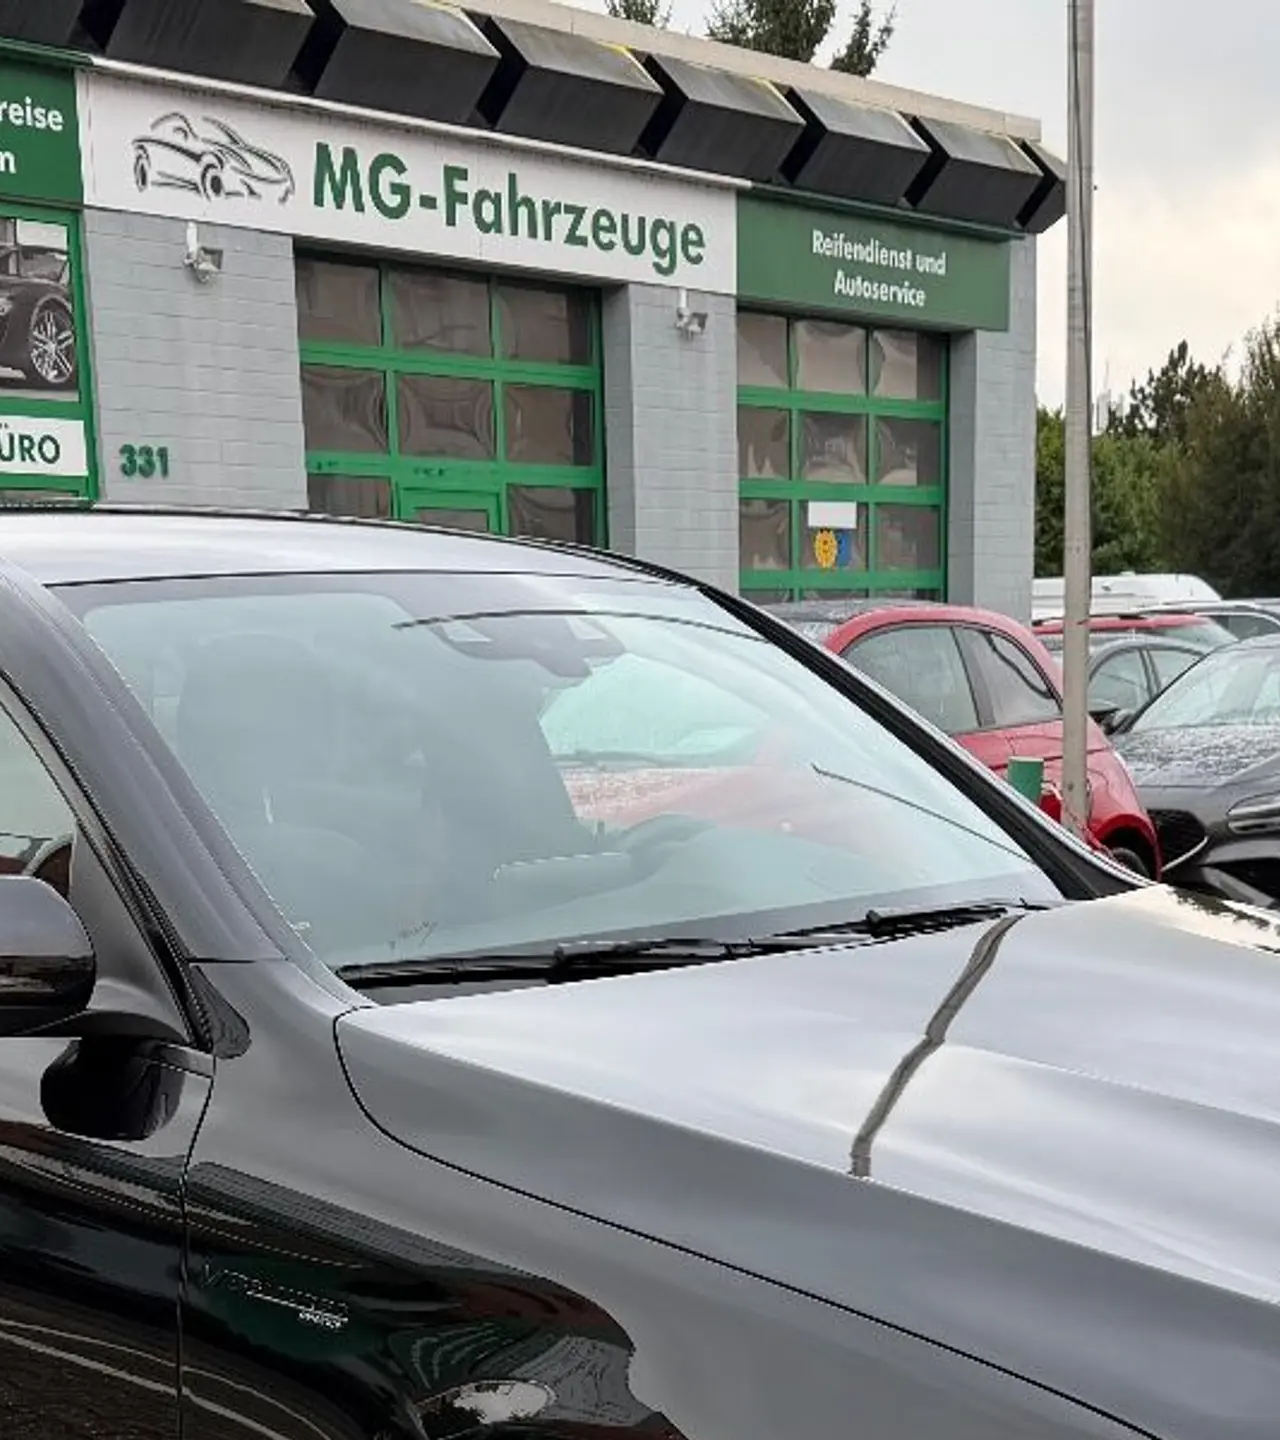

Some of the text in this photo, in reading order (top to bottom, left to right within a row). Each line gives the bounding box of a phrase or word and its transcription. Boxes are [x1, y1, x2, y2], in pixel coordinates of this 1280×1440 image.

[313, 141, 707, 277] MG-Fahrzeuge
[811, 229, 947, 276] Reifendienst und
[833, 269, 927, 307] Autoservice
[119, 444, 169, 478] 331
